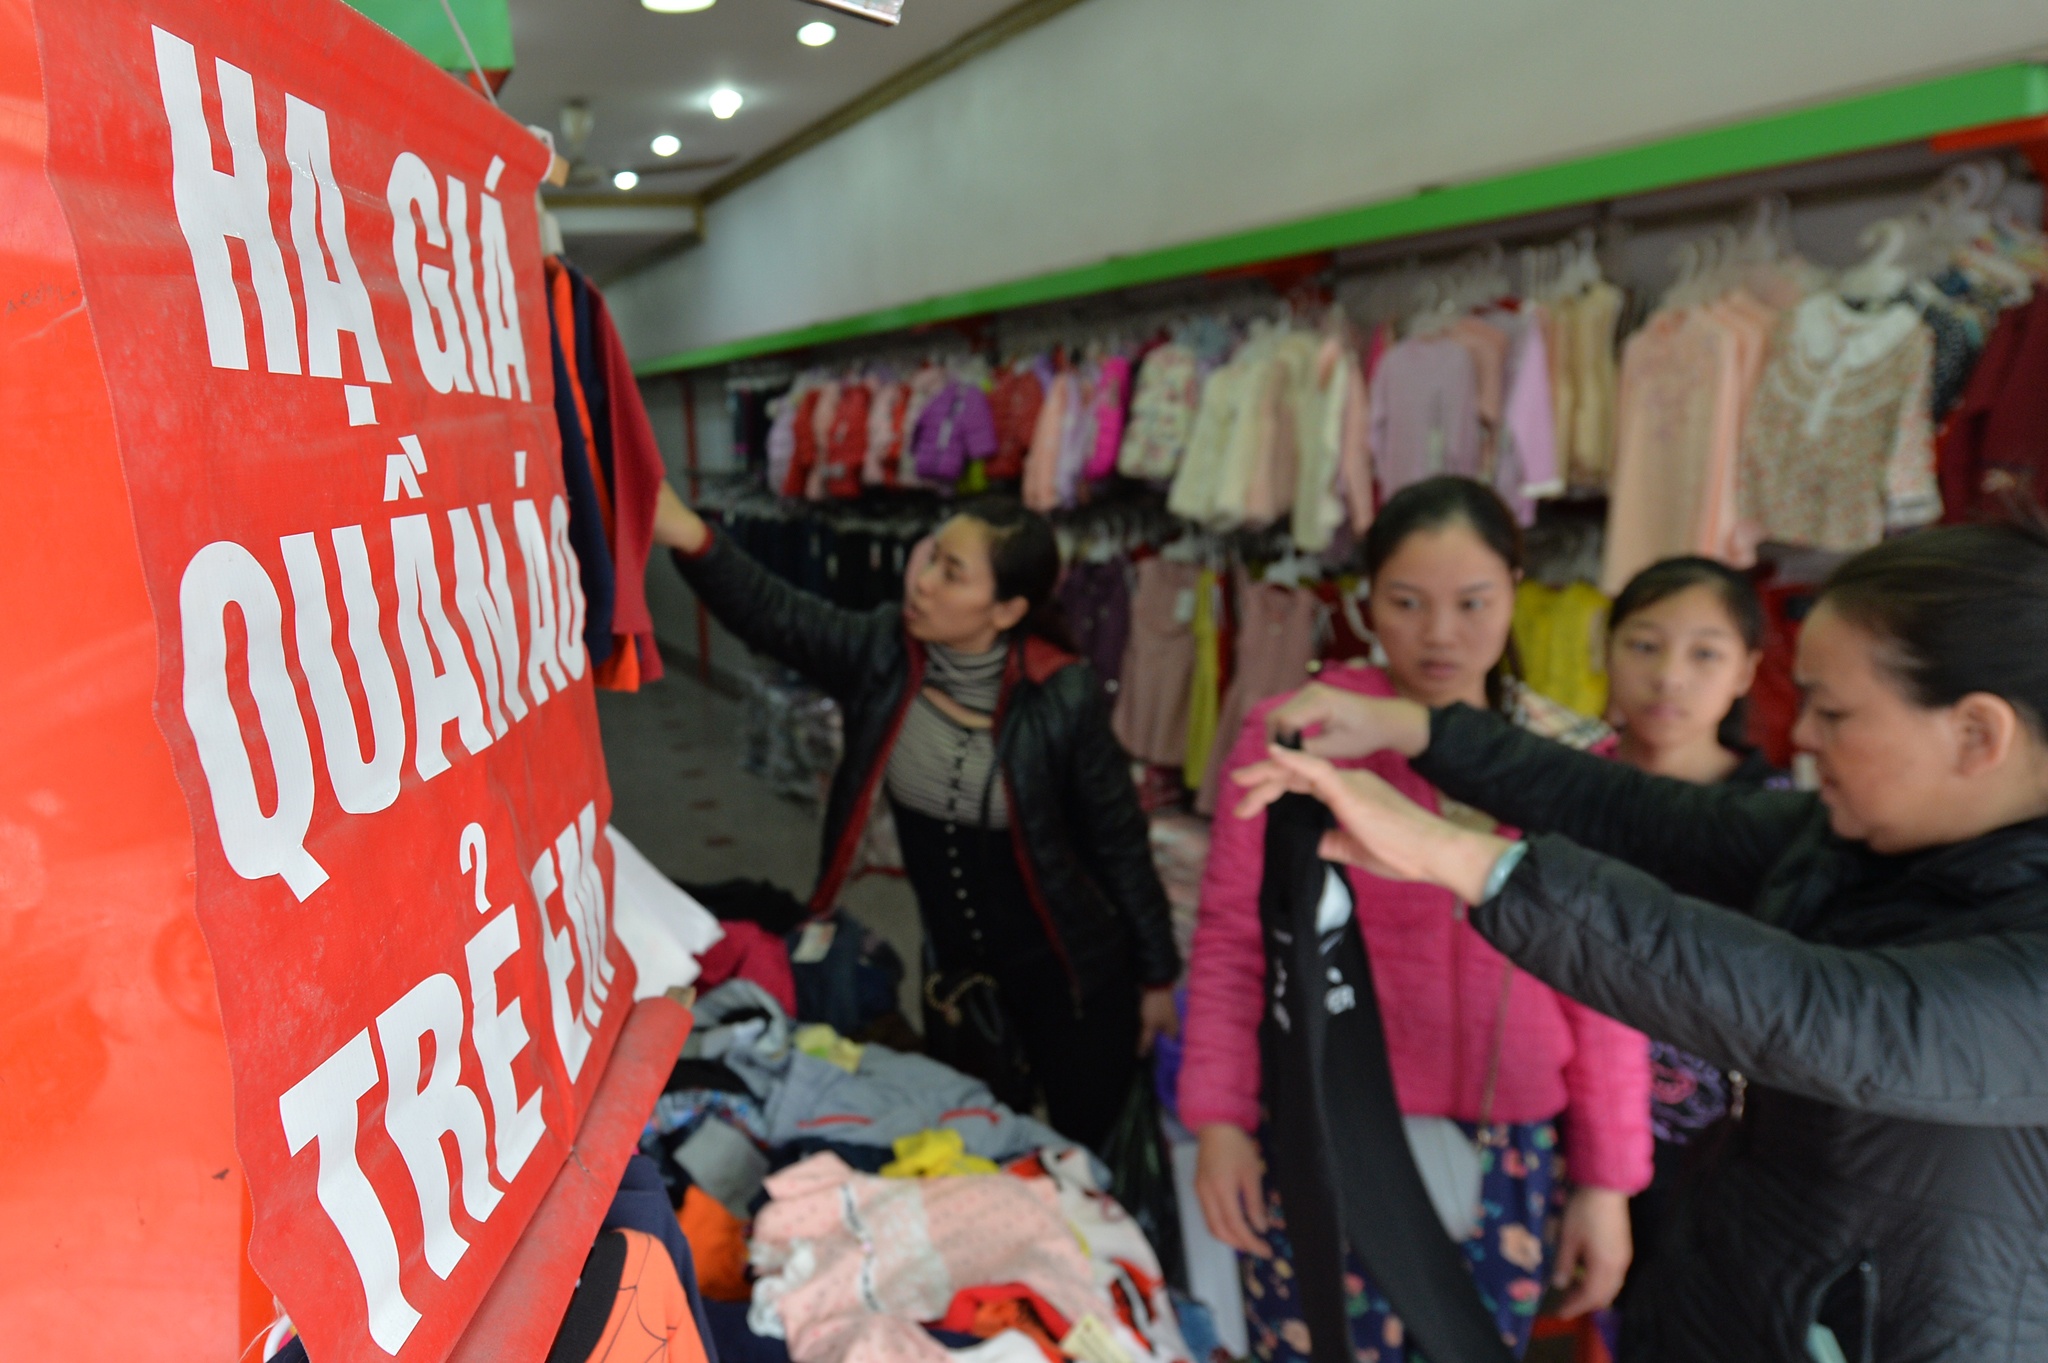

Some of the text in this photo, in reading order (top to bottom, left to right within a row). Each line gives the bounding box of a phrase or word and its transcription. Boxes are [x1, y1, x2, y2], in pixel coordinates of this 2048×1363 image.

[151, 24, 531, 426] HẠ GIÁ
[180, 434, 587, 903] QUẦN ÁO
[279, 801, 614, 1357] TRẺ EM
